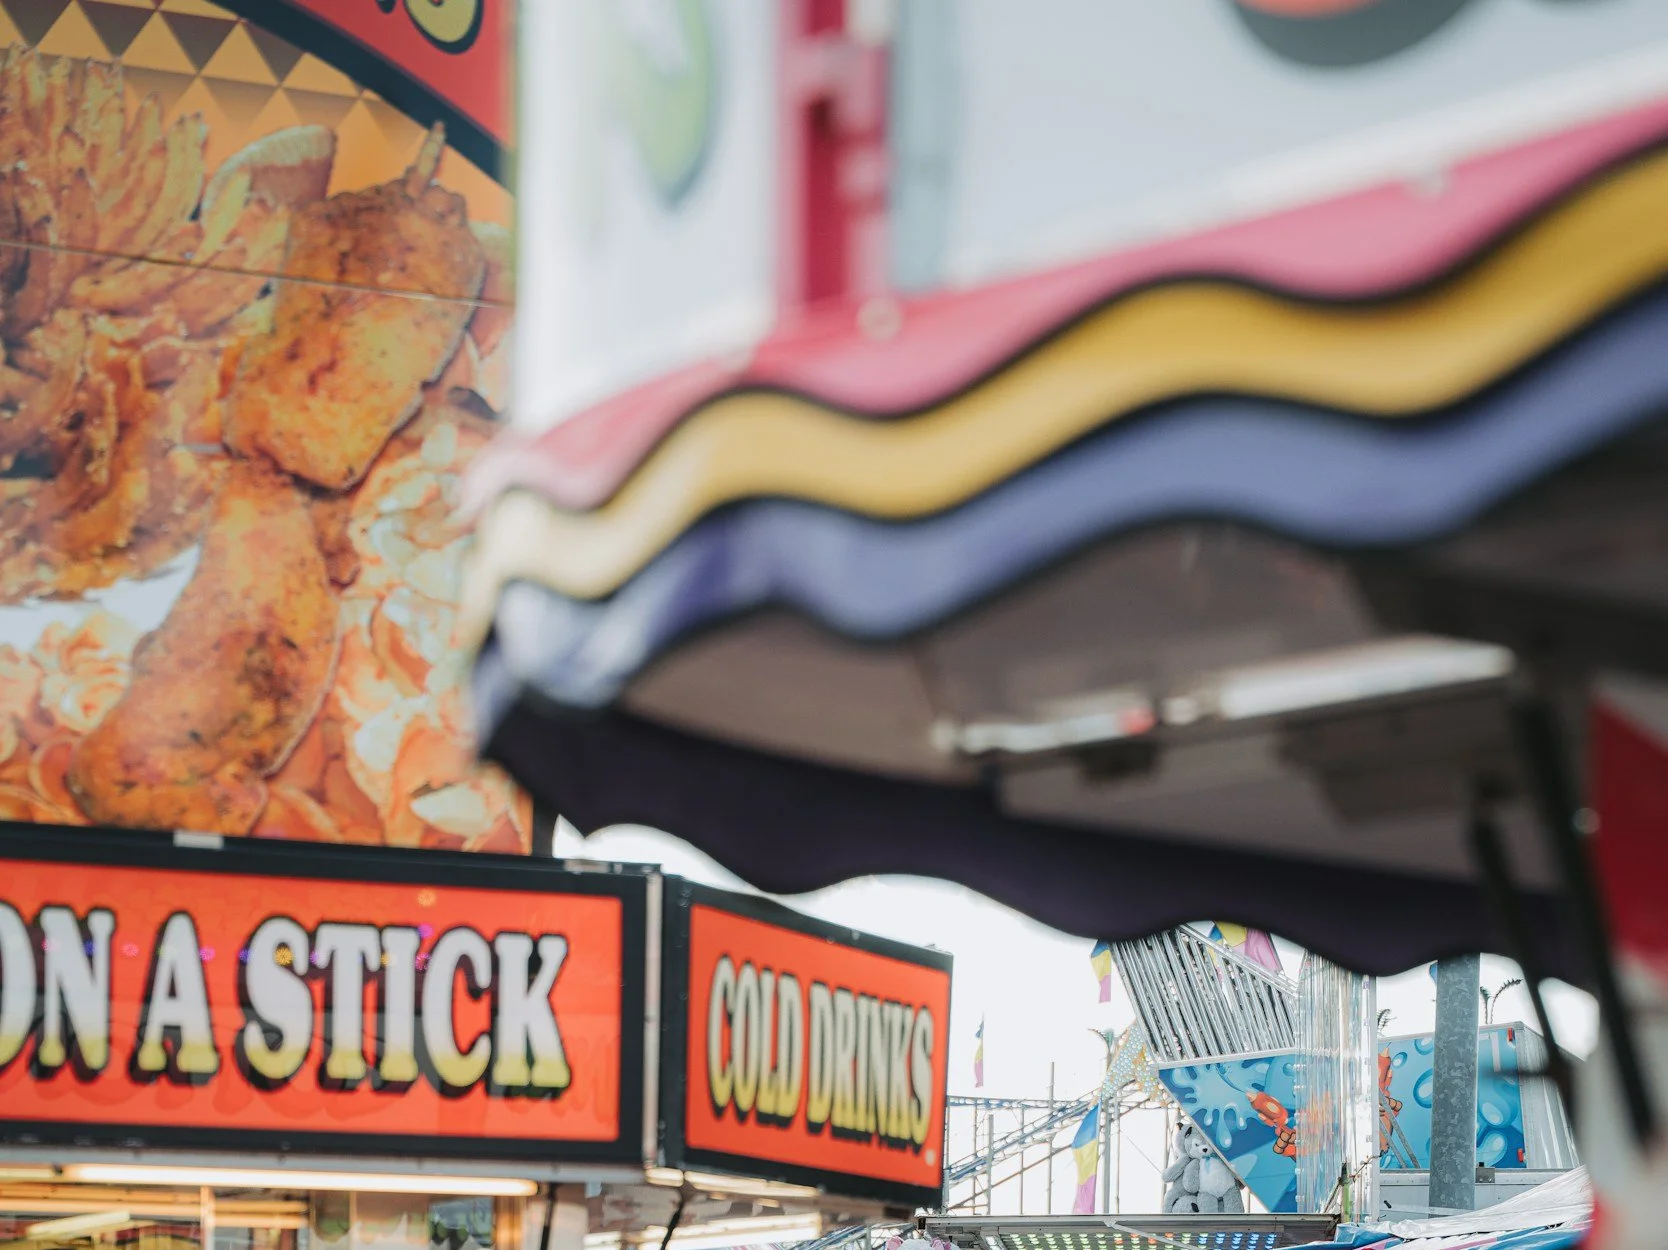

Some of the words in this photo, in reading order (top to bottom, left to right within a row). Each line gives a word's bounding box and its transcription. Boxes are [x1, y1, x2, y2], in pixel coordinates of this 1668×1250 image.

[129, 908, 220, 1086] A
[234, 912, 572, 1100] STICK
[707, 952, 804, 1128] COLD
[807, 979, 934, 1152] DRINKS
